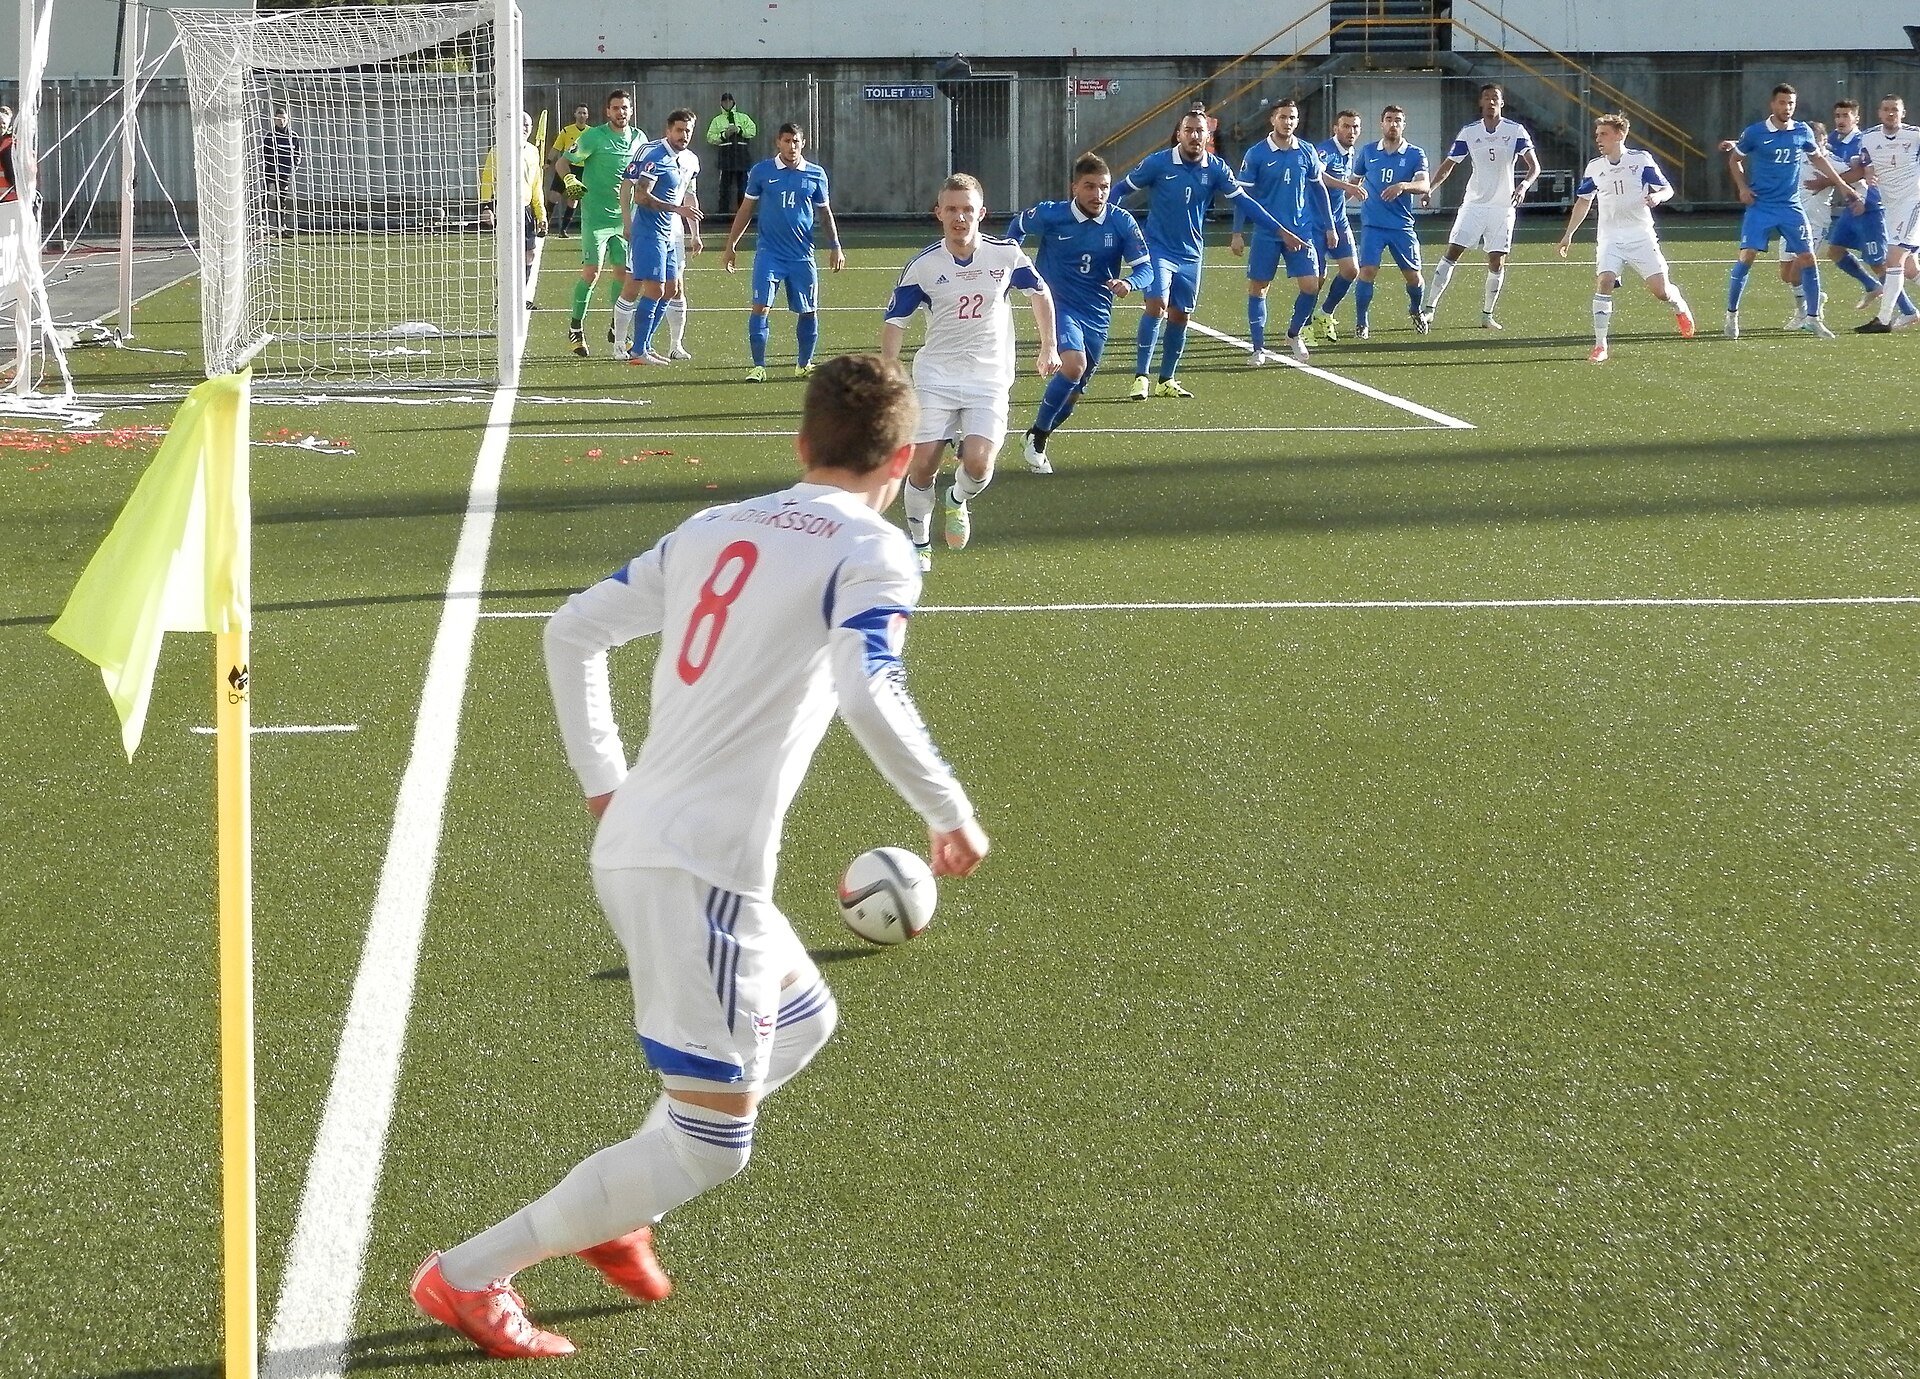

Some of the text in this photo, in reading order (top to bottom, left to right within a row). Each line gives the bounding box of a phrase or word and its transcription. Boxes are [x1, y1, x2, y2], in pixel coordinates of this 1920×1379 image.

[865, 88, 906, 98] TOILET
[1488, 148, 1496, 162] 5
[1774, 148, 1791, 164] 22
[1283, 168, 1292, 185] 4
[1381, 168, 1394, 184] 19
[1185, 186, 1192, 205] 9
[1613, 180, 1624, 195] 11
[780, 190, 796, 209] 14
[1865, 241, 1878, 256] 10
[1080, 253, 1091, 274] 3
[958, 293, 983, 320] 22
[676, 539, 759, 687] 8
